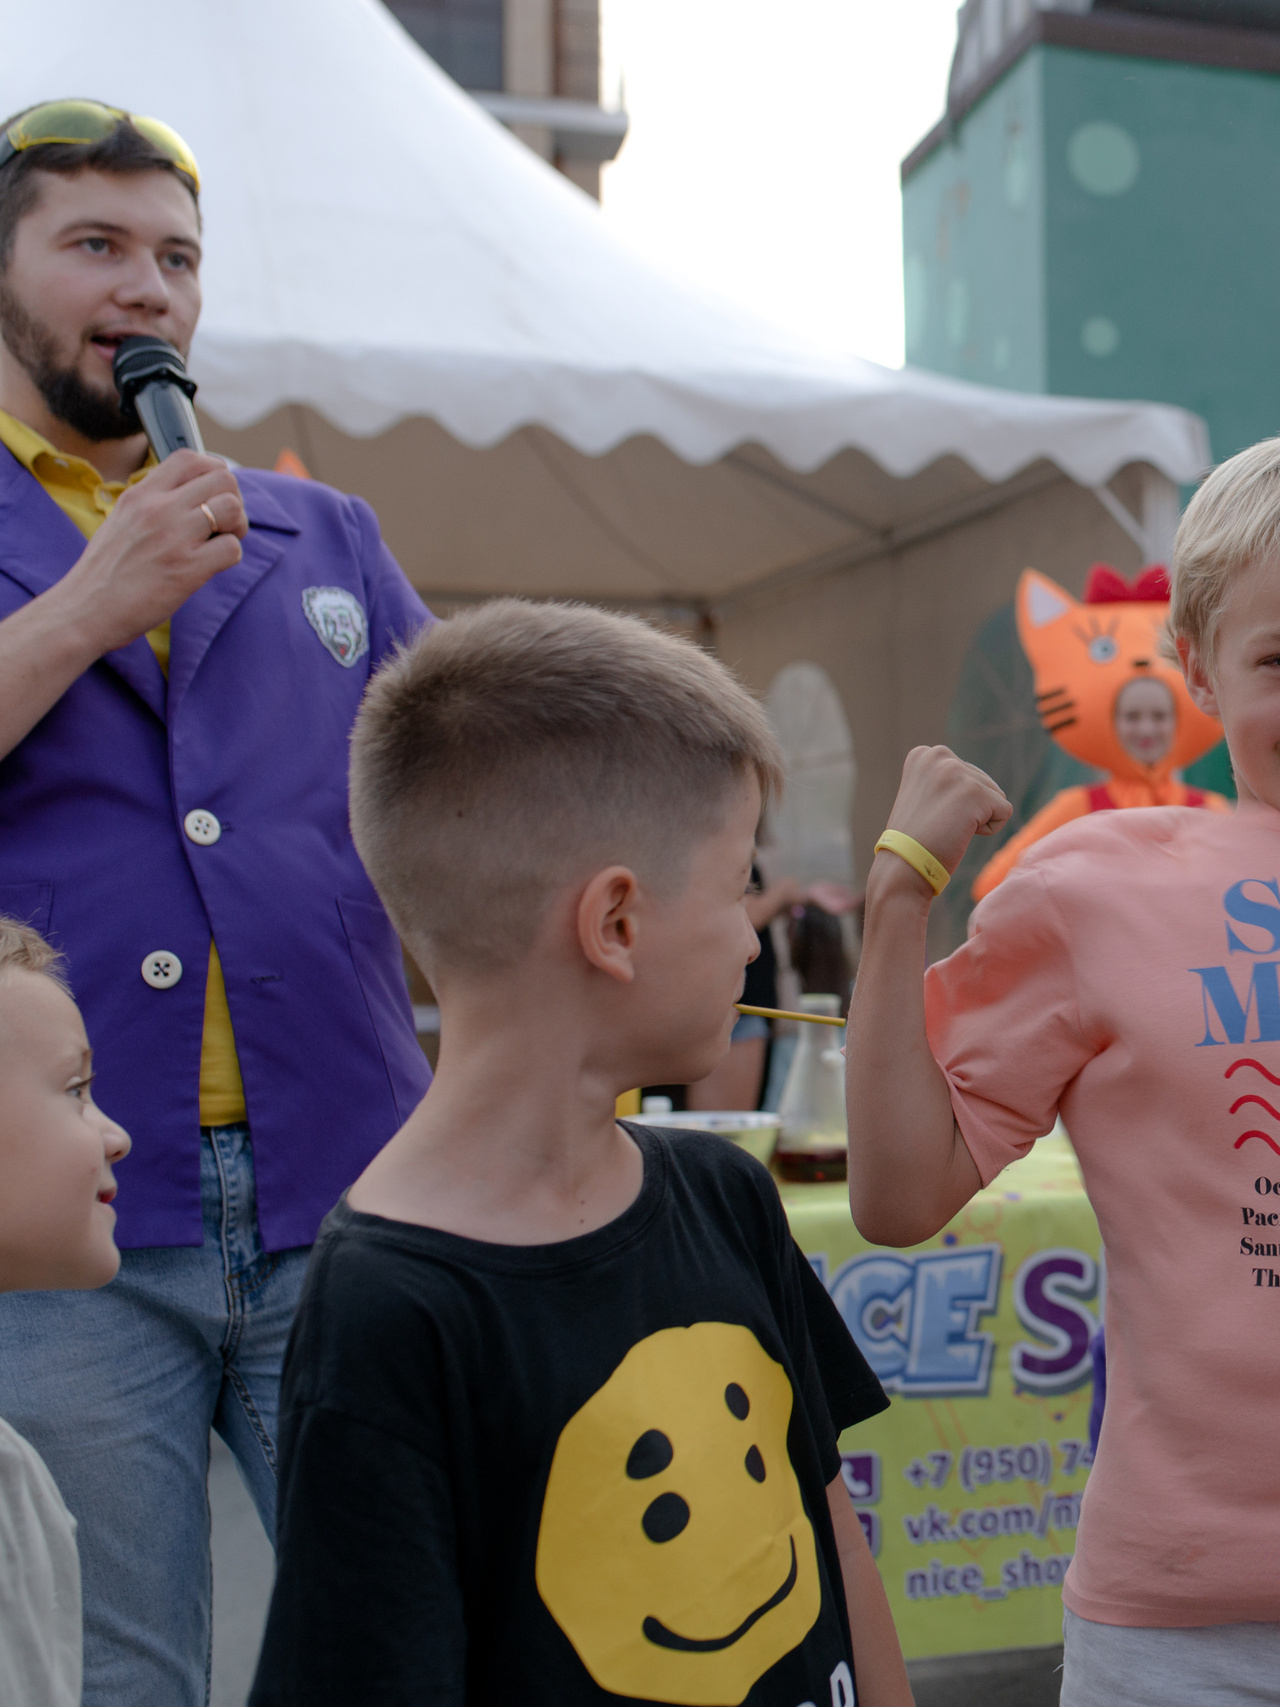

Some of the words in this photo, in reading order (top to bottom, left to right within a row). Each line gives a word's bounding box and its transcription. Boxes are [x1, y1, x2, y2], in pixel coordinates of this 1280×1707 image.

[808, 1247, 1000, 1394] CE
[905, 1451, 951, 1488] +7
[958, 1442, 1050, 1493] (950)
